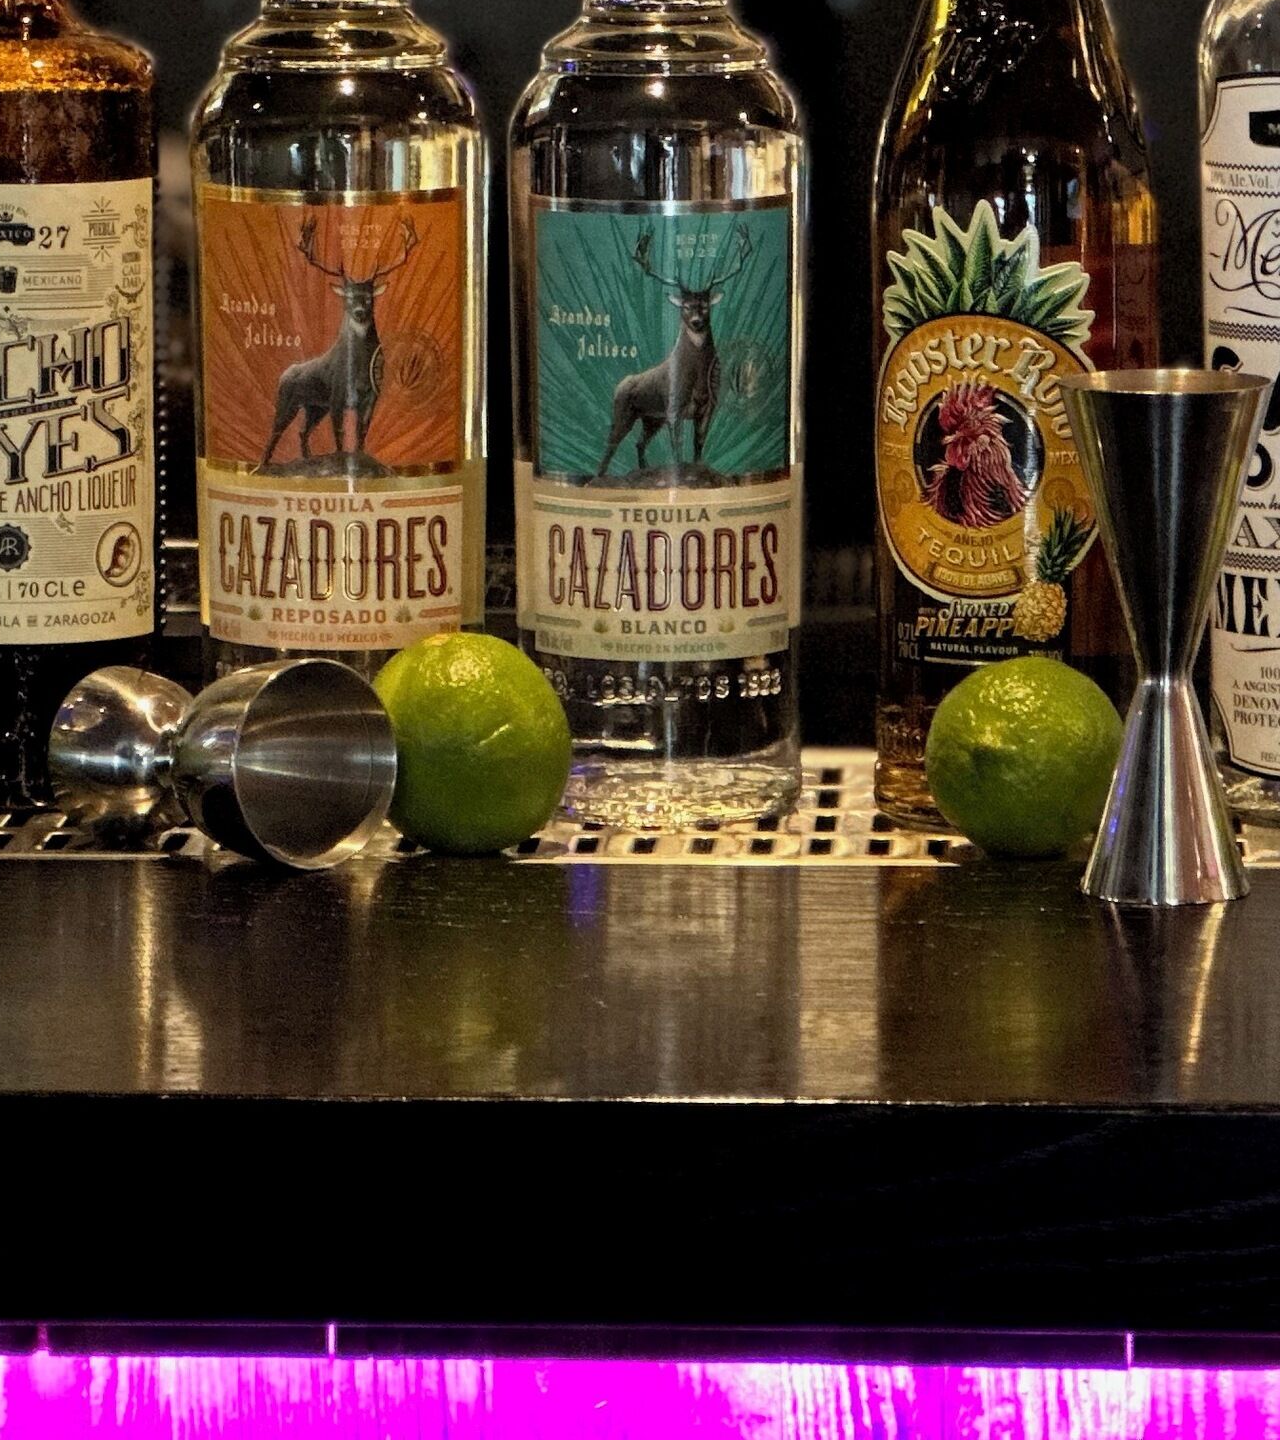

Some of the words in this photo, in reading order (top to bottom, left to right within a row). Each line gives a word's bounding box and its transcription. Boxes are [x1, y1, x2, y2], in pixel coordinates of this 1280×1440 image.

[38, 225, 71, 249] 27
[22, 274, 82, 287] MEXICANO
[576, 334, 638, 361] Jalisco
[883, 329, 1013, 434] Rooster
[1003, 336, 1074, 440] Rojo
[14, 480, 73, 513] ANCHO
[77, 464, 137, 511] LIQUEUR
[283, 496, 375, 515] TEQUILA
[618, 508, 712, 526] TEQUILA
[219, 511, 448, 602] CAZADORES
[548, 522, 779, 612] CAZADORES
[18, 581, 40, 597] 70
[43, 612, 117, 627] ZARAGOZA
[271, 607, 388, 625] REPOSADO
[620, 618, 708, 635] BLANCO
[914, 615, 1026, 638] PINEAPPL
[930, 641, 971, 655] NATURAL
[974, 645, 1019, 657] FLAVOUR
